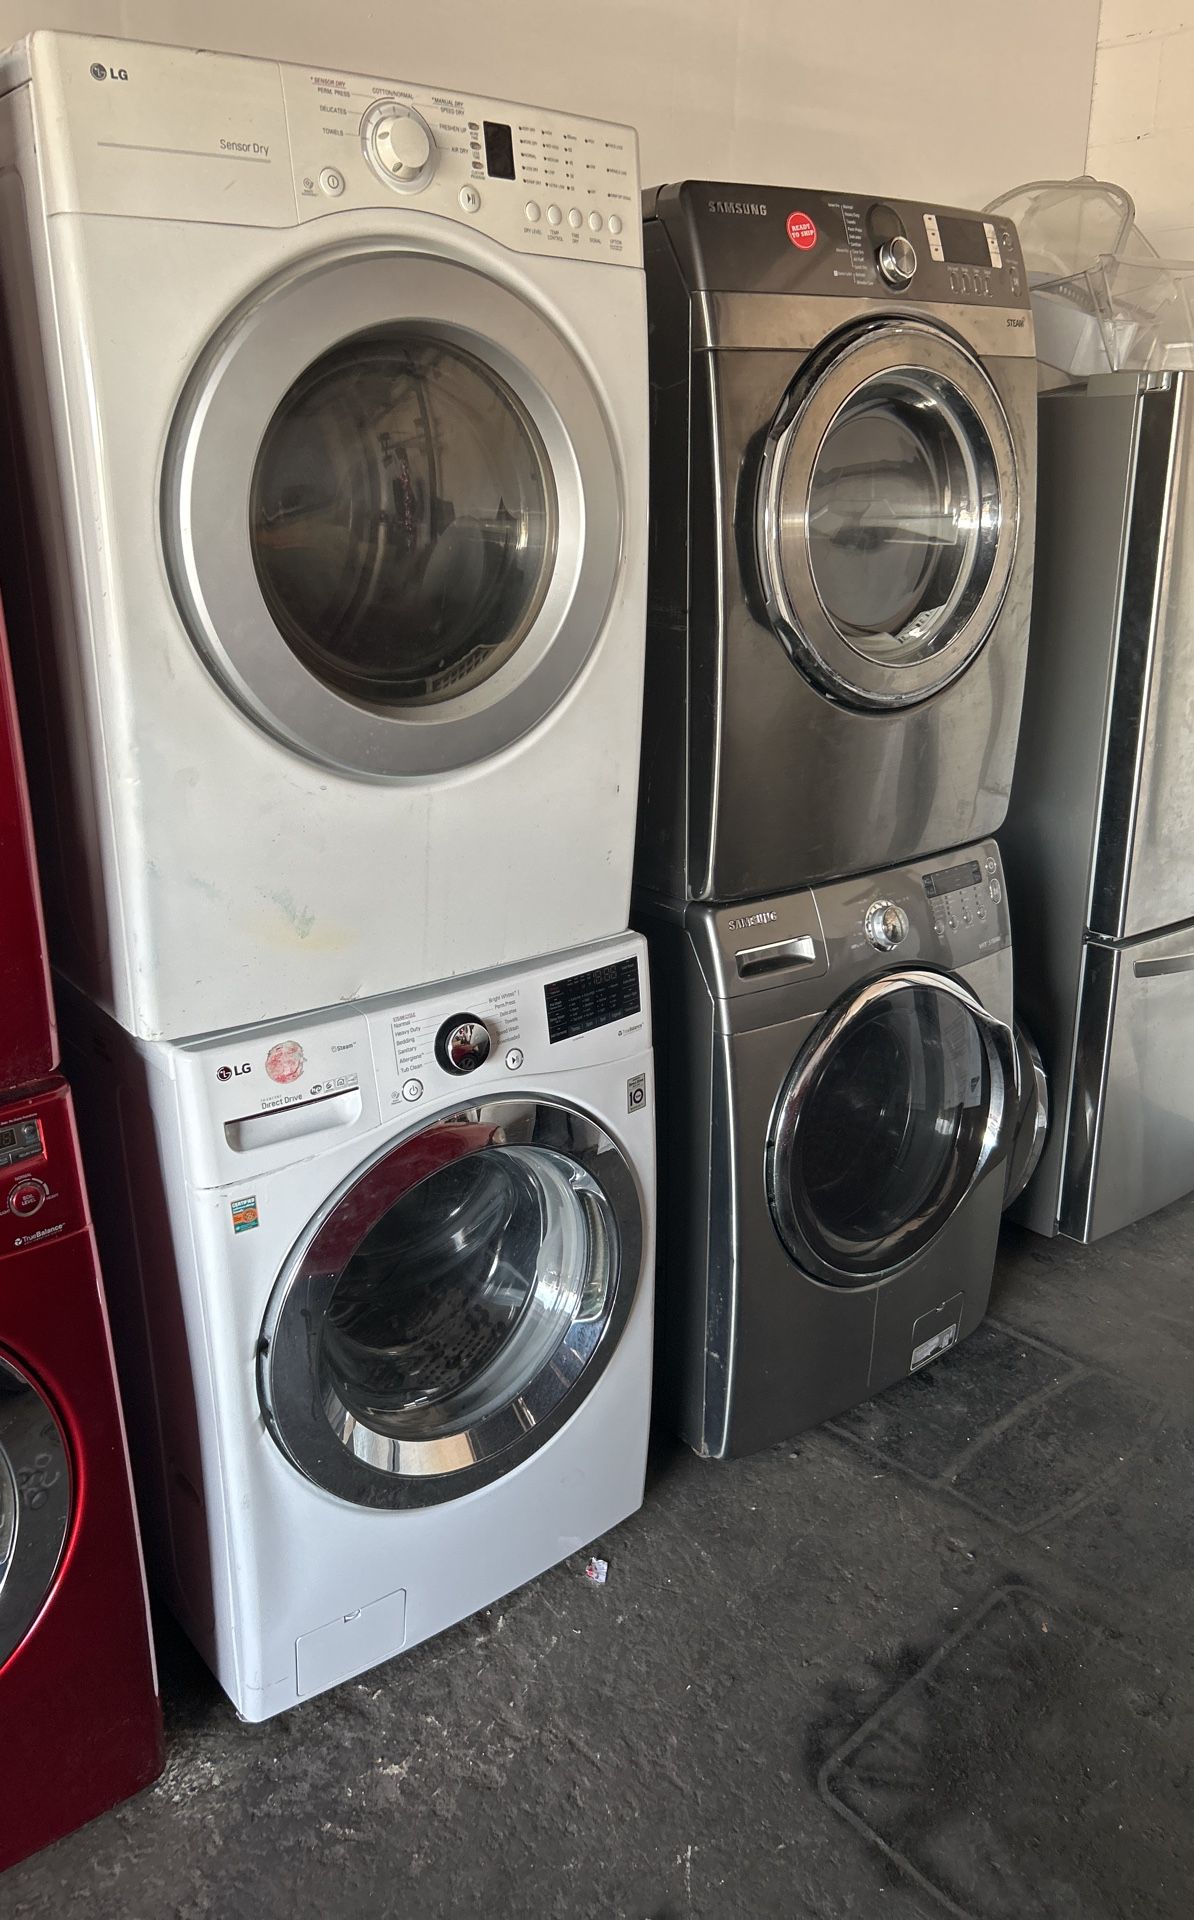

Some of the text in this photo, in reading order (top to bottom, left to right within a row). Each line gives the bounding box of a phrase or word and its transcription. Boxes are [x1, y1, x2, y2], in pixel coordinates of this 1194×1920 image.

[110, 68, 128, 80] LG
[320, 105, 348, 115] DELICATES
[322, 128, 344, 136] TOWELS
[220, 139, 269, 156] Sensor Dry
[708, 201, 767, 216] SAMSUNG
[792, 223, 811, 232] READY
[728, 911, 777, 930] SAMSUNG
[394, 1020, 410, 1028] Normal
[395, 1029, 410, 1037] Heavy
[396, 1037, 415, 1046] Bedding
[398, 1046, 417, 1055] Sanitary
[234, 1063, 252, 1076] LG
[262, 1094, 302, 1110] Direct Drive
[630, 1088, 644, 1106] 10
